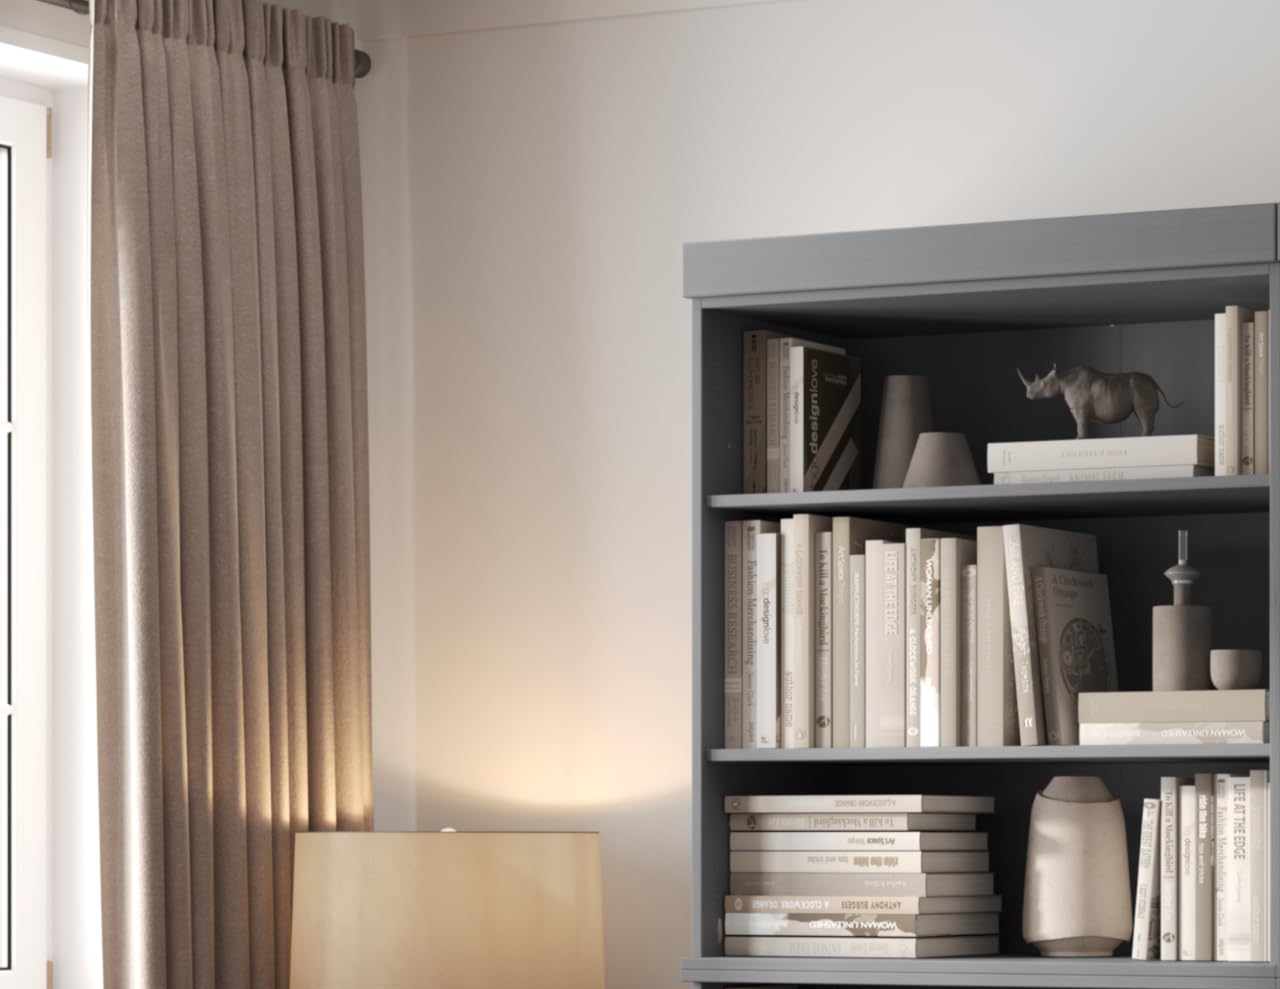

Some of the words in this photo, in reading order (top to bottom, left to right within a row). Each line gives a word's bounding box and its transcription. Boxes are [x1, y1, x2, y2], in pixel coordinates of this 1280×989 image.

[886, 551, 897, 571] LIFE
[886, 573, 897, 585] AT
[886, 587, 897, 607] THE
[886, 608, 897, 636] EDGE
[1234, 783, 1246, 802] LIFE
[1234, 803, 1246, 816] AT
[1234, 817, 1246, 835] THE
[1234, 836, 1246, 860] EDGE
[841, 901, 869, 910] BURGESS
[870, 901, 902, 910] ANTHONY
[861, 920, 897, 928] WOMAN
